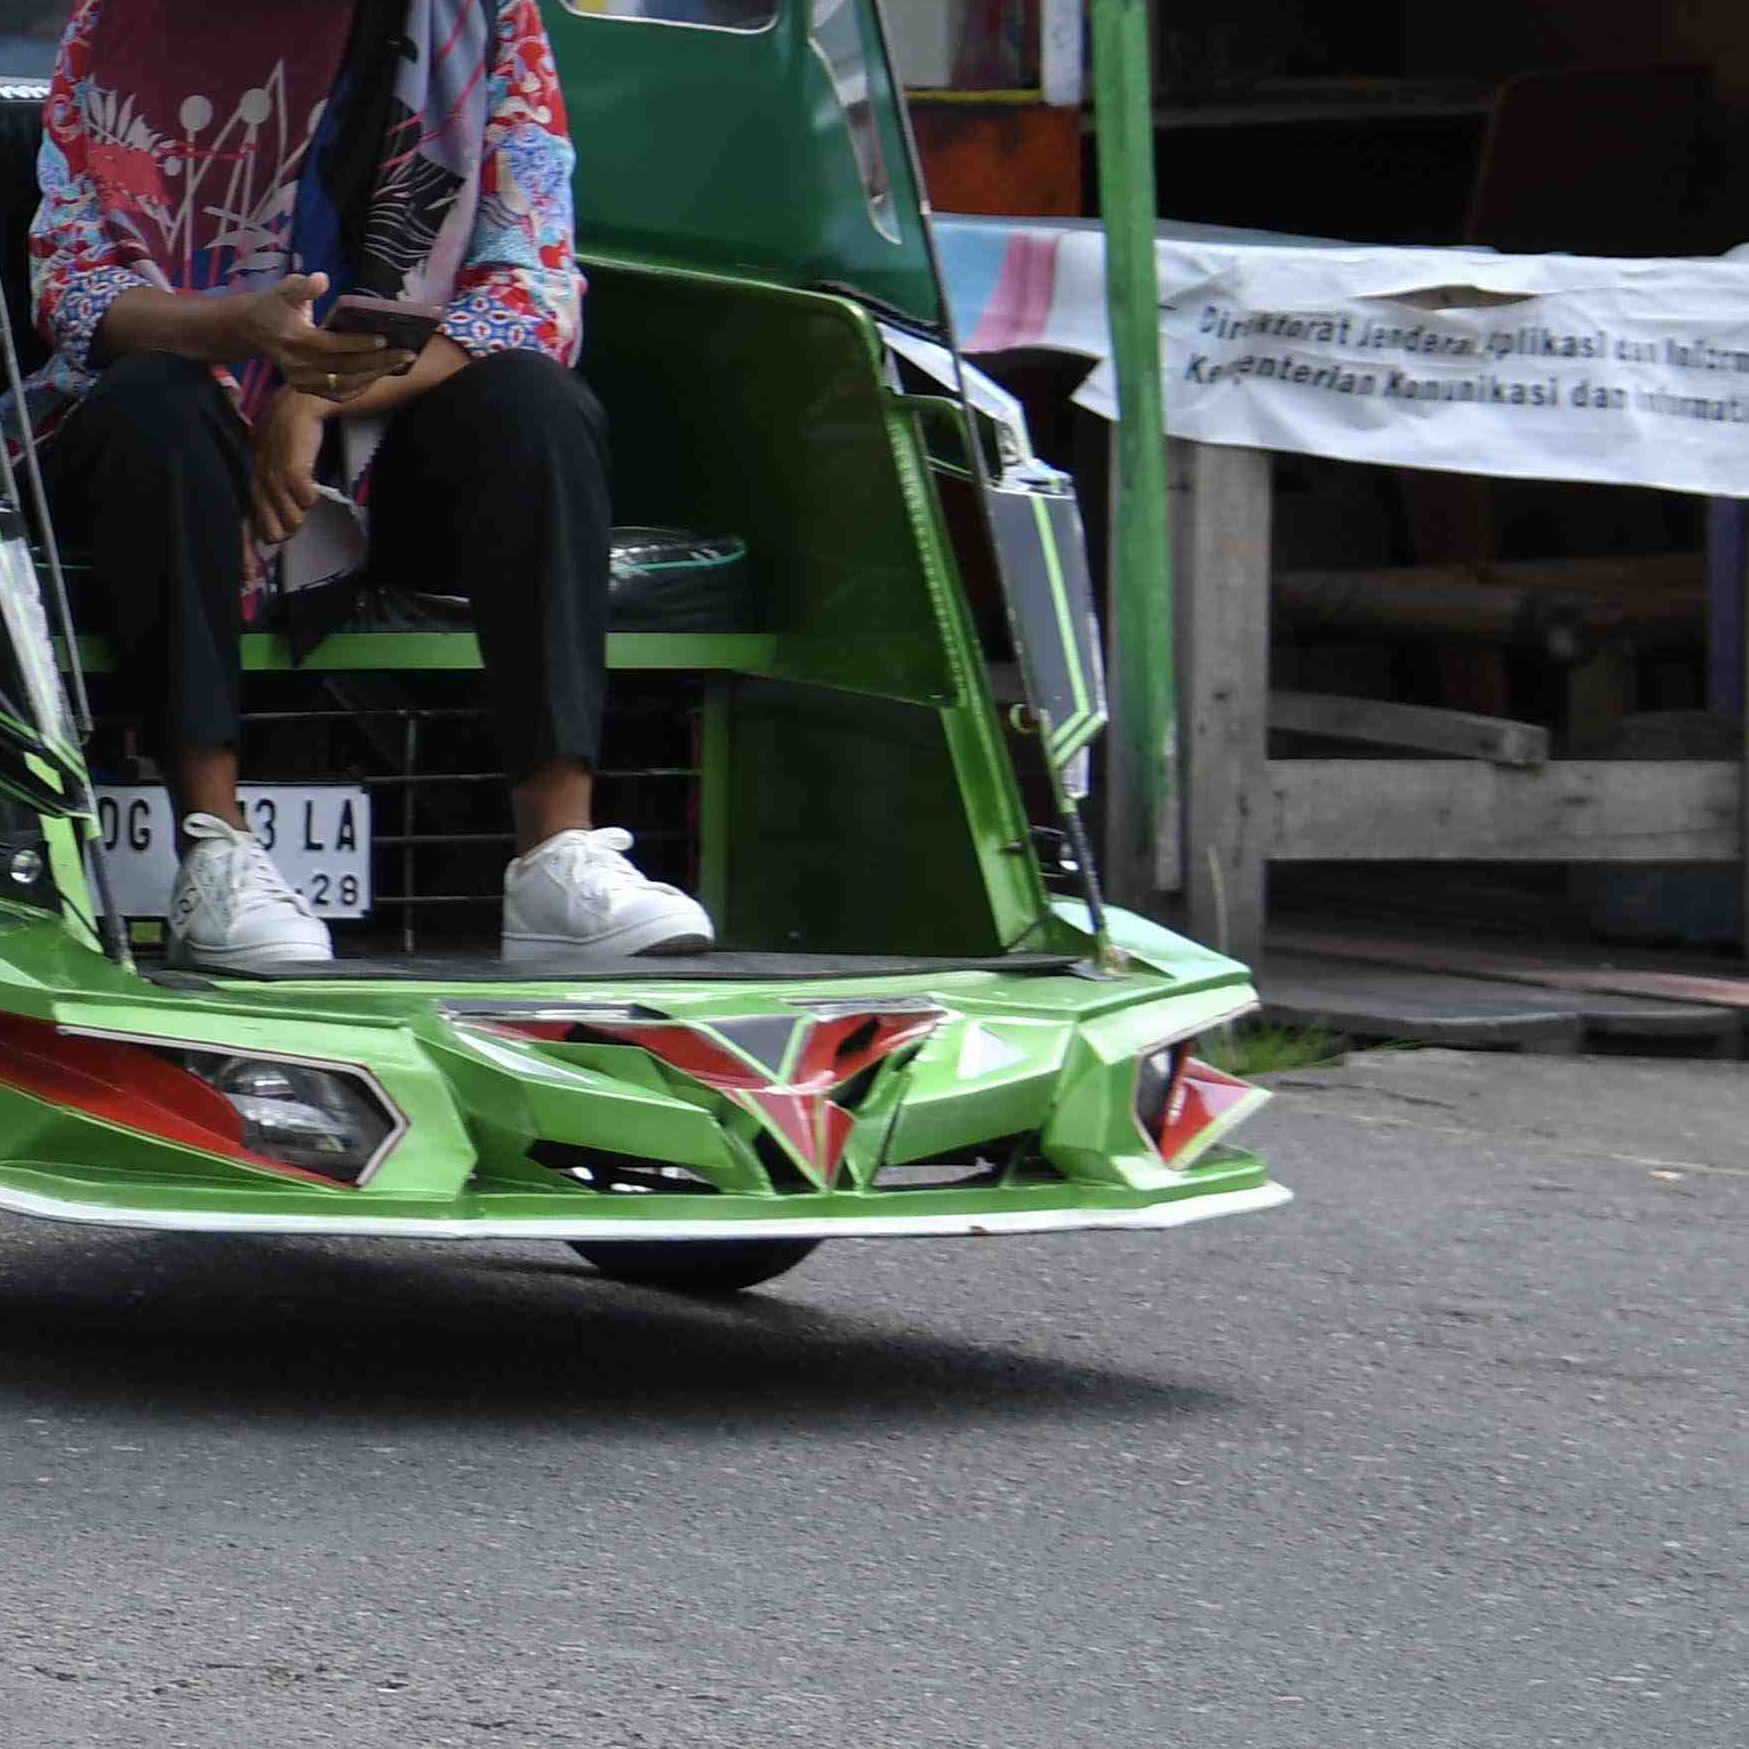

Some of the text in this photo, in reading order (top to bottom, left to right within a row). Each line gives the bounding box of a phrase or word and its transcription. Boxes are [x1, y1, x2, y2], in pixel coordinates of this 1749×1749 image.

[1199, 304, 1351, 345] Dirktorat
[1356, 317, 1477, 355] Jendera
[1185, 352, 1376, 394] Keenterian
[1570, 378, 1626, 409] dan
[304, 798, 356, 852] LA
